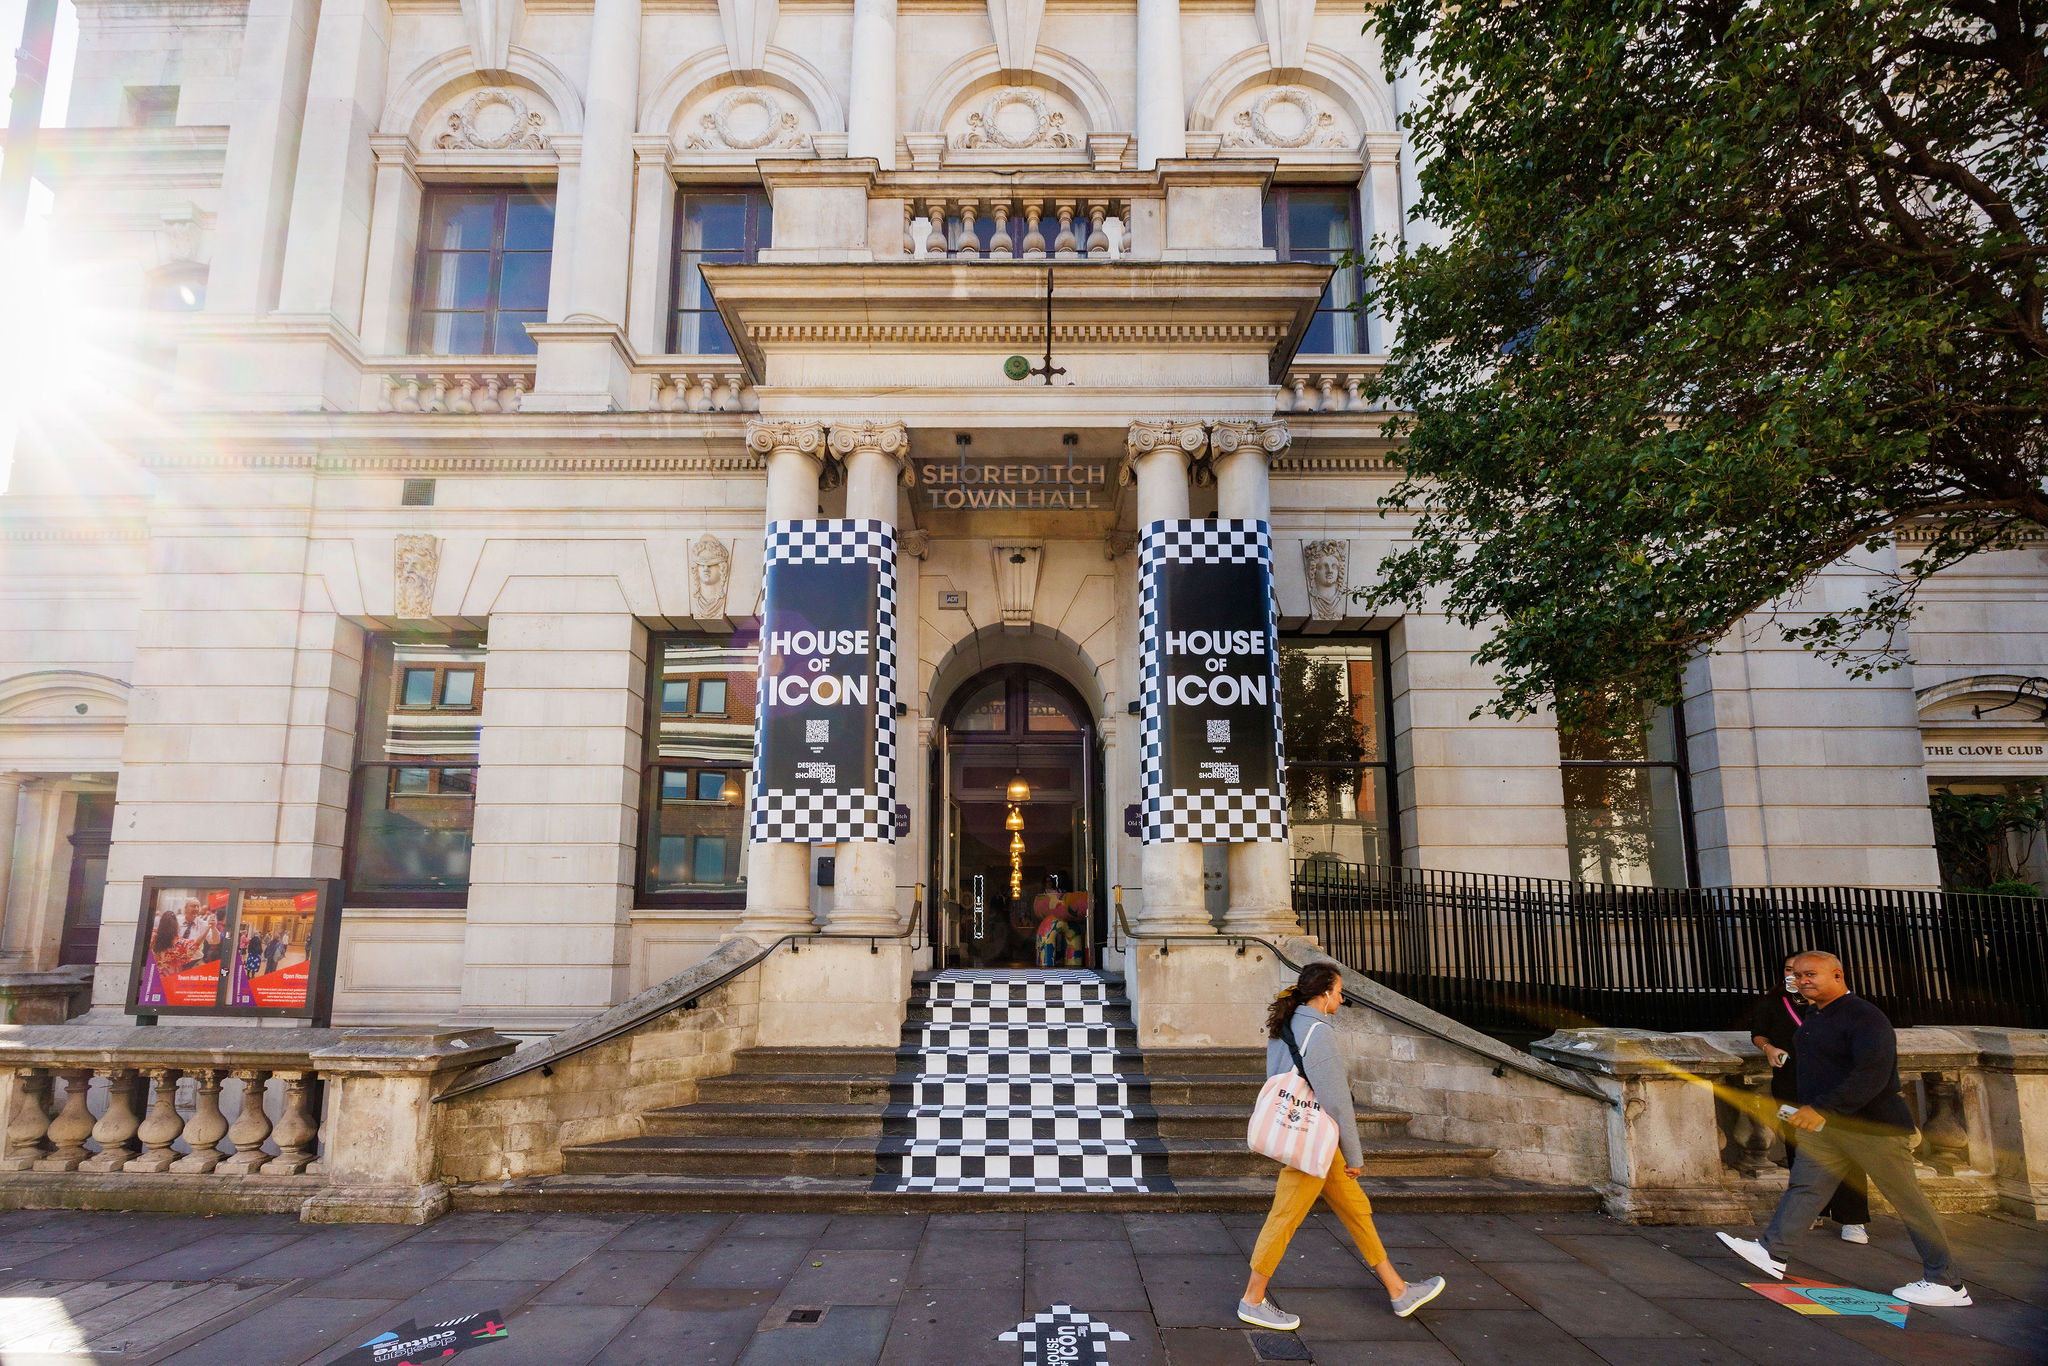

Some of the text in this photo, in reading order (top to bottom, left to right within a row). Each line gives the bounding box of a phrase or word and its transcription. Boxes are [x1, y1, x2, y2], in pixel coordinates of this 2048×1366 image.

[922, 464, 1105, 485] SHOREDITCH
[927, 489, 1099, 509] TOWN HALL
[770, 630, 869, 655] HOUSE
[1165, 630, 1265, 655] HOUSE
[808, 658, 831, 672] OF
[1205, 658, 1227, 672] OF
[769, 675, 868, 706] ICON
[1167, 674, 1267, 706] ICON
[1925, 746, 2043, 756] THE CLOVE CLUB
[373, 1330, 456, 1356] culture
[374, 1335, 457, 1363] design
